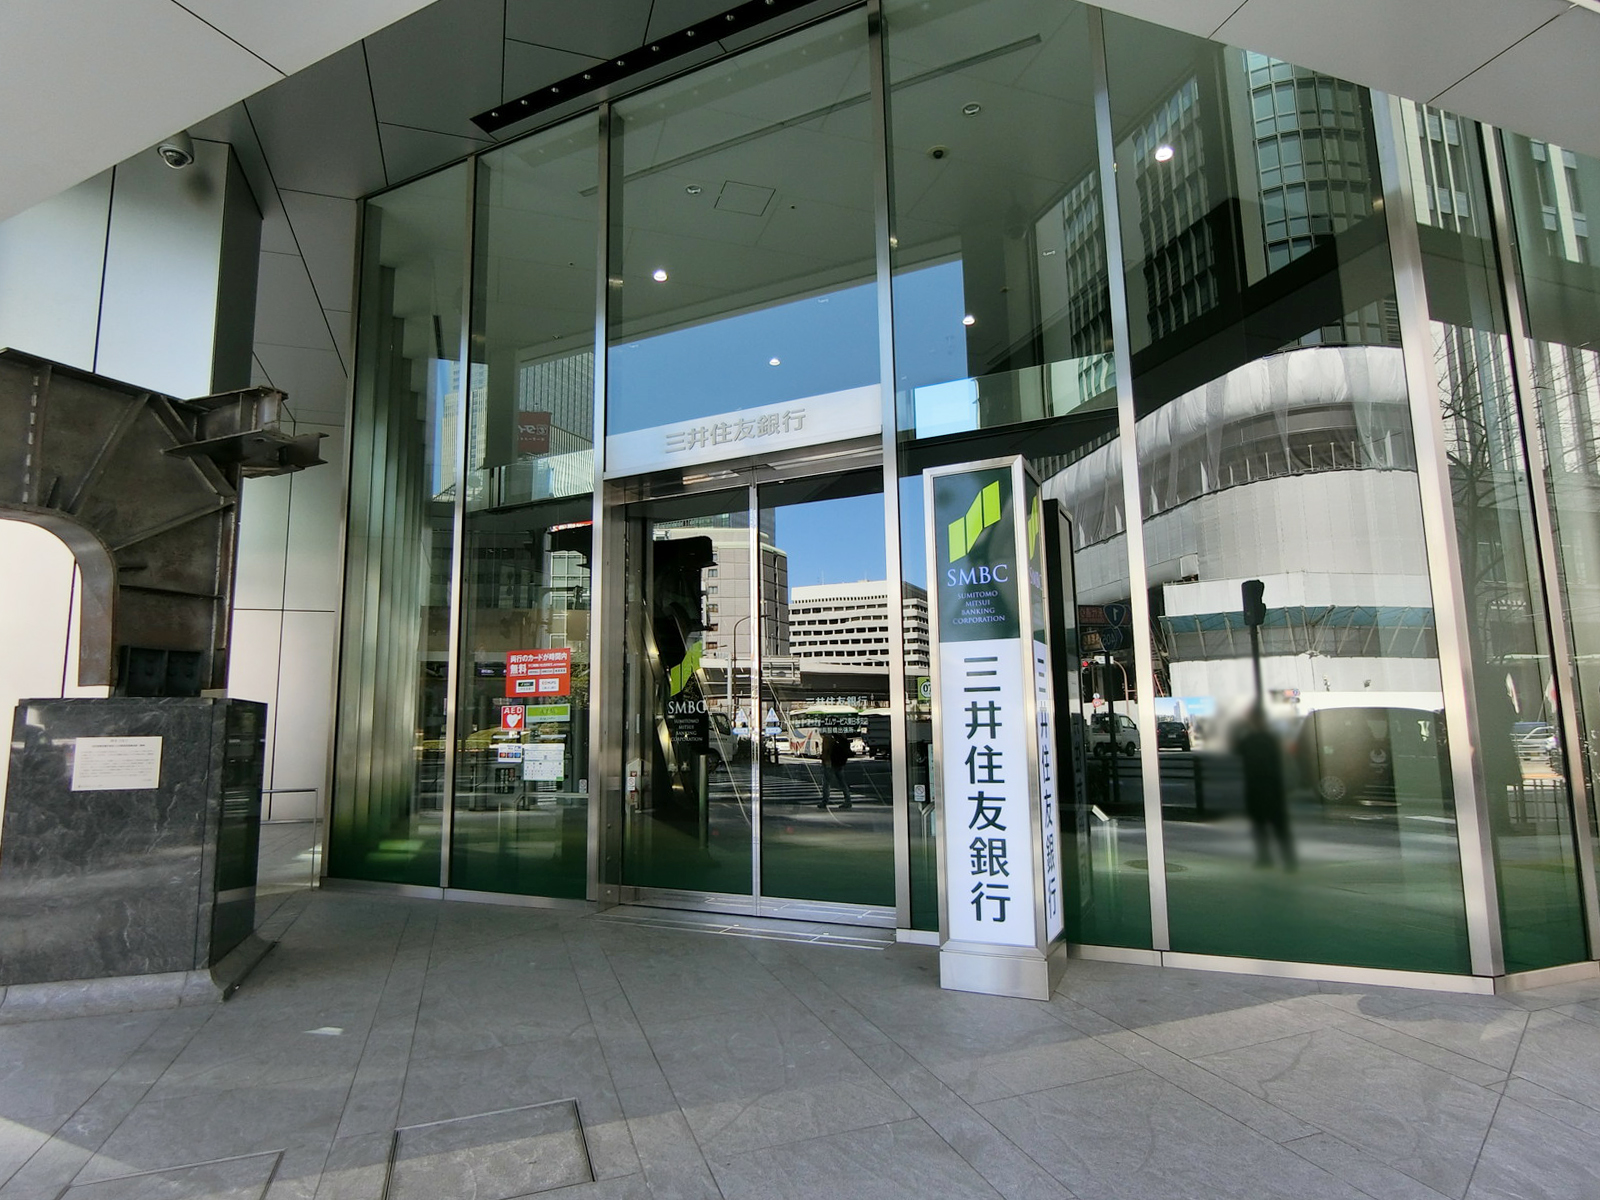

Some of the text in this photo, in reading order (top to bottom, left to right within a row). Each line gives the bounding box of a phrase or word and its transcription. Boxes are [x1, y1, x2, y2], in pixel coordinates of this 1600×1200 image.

[665, 408, 806, 454] 三井住友銀行
[947, 564, 1008, 587] SMBC
[957, 590, 998, 600] SUMITOMO
[965, 599, 991, 607] MITSUI
[961, 607, 995, 616] BANKING
[952, 615, 1005, 625] CORPORATION
[668, 700, 706, 714] SMBC
[805, 695, 868, 709] 三井住友銀行
[964, 656, 1011, 922] 三井住友銀行
[1037, 657, 1057, 919] 三井住友銀行
